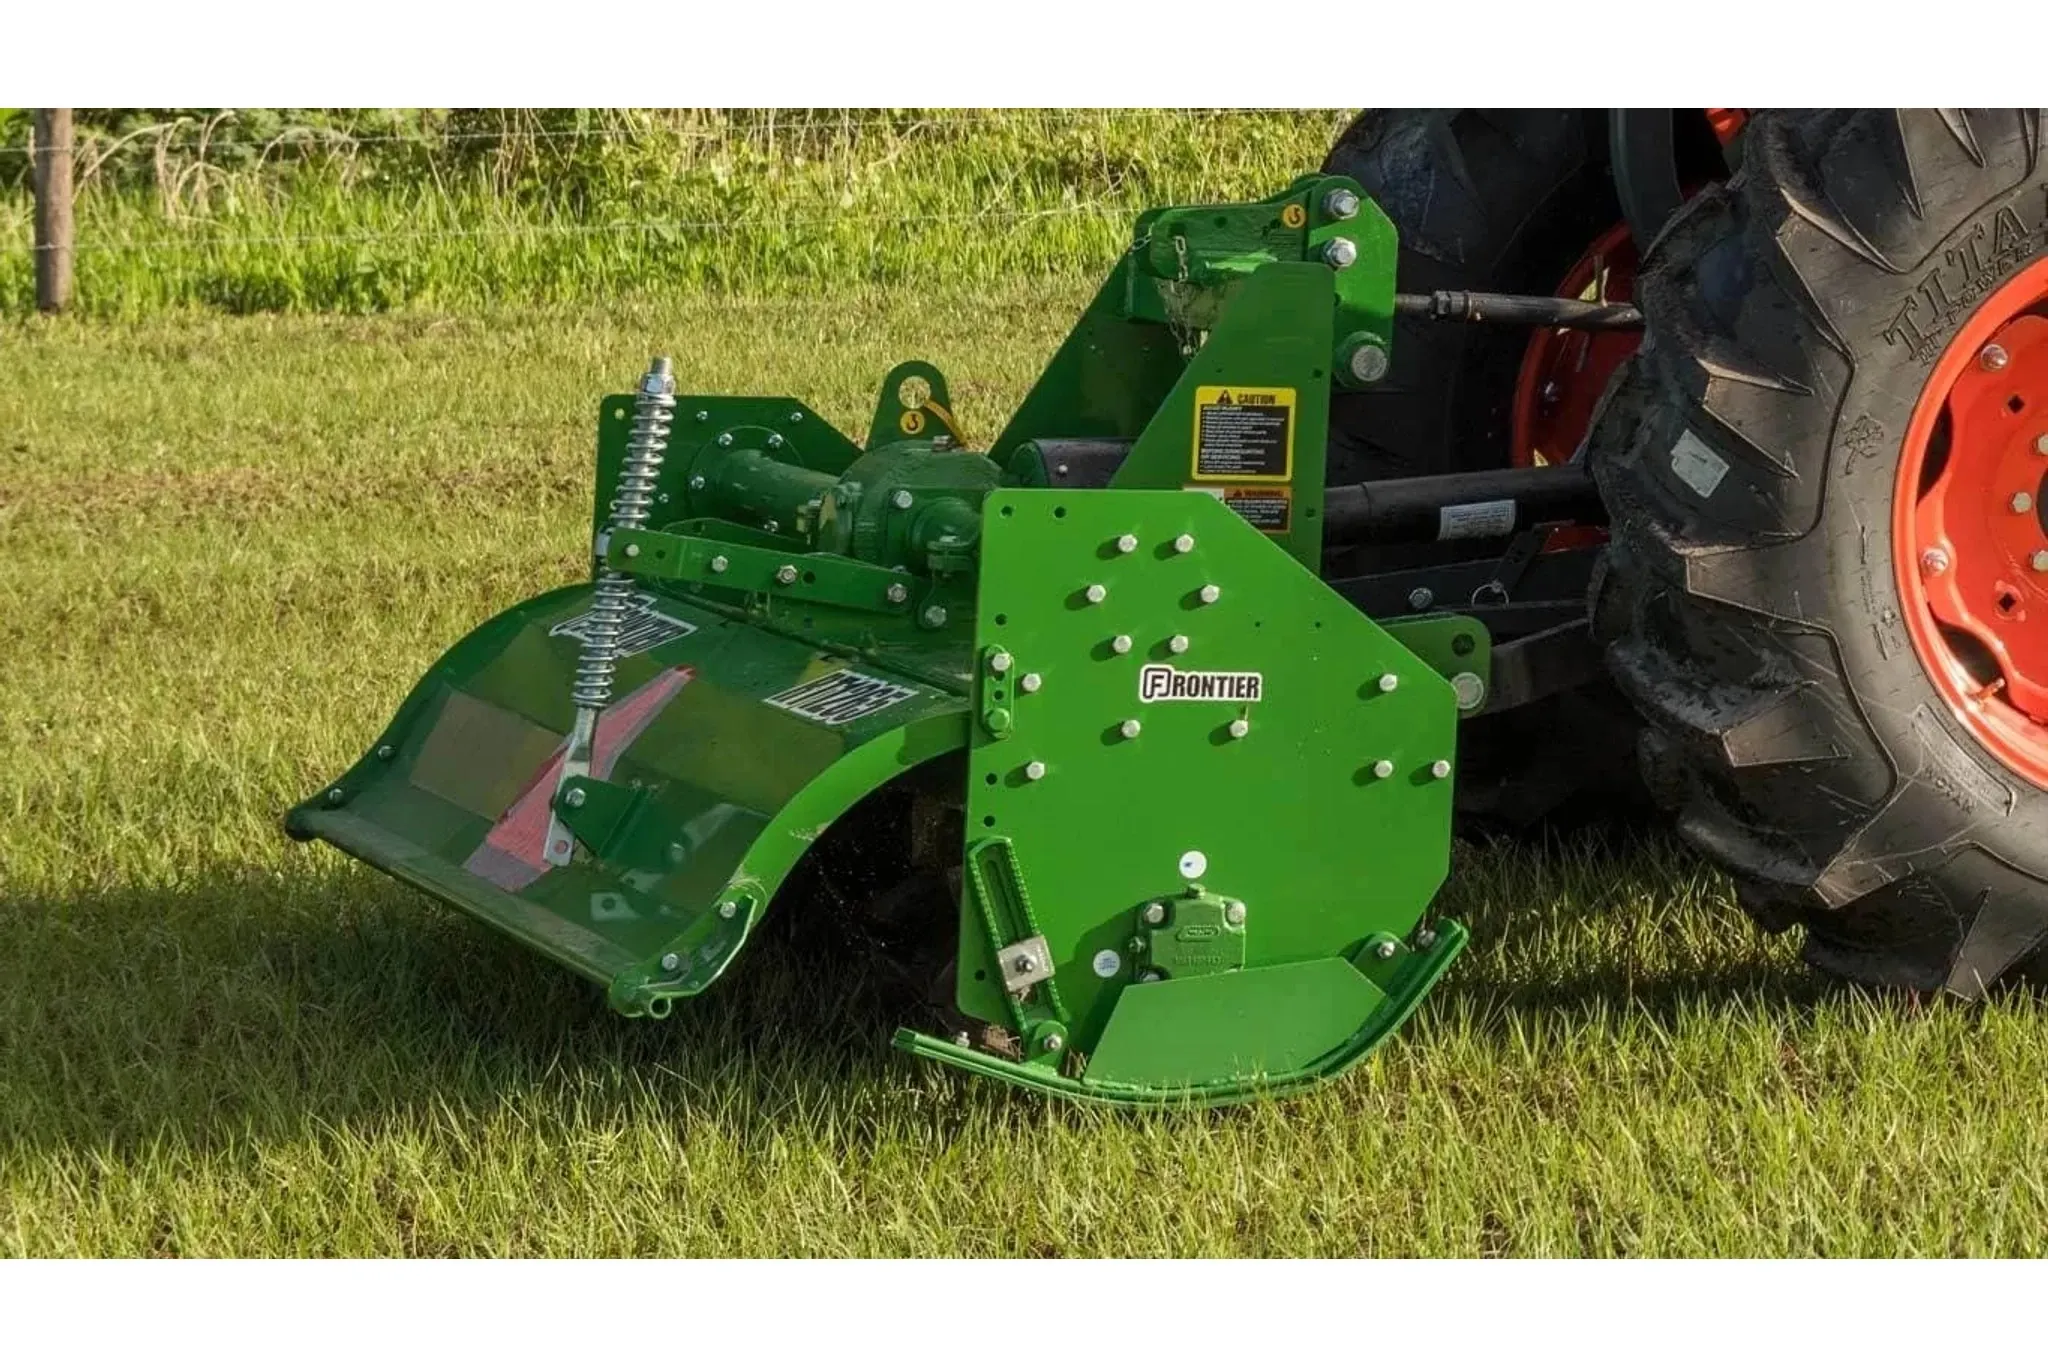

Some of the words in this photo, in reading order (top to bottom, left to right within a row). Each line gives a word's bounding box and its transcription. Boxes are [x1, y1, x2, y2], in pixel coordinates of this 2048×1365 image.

[1882, 182, 2048, 361] TITA
[1237, 393, 1276, 405] CAUTION
[1142, 667, 1260, 699] FRONTIER
